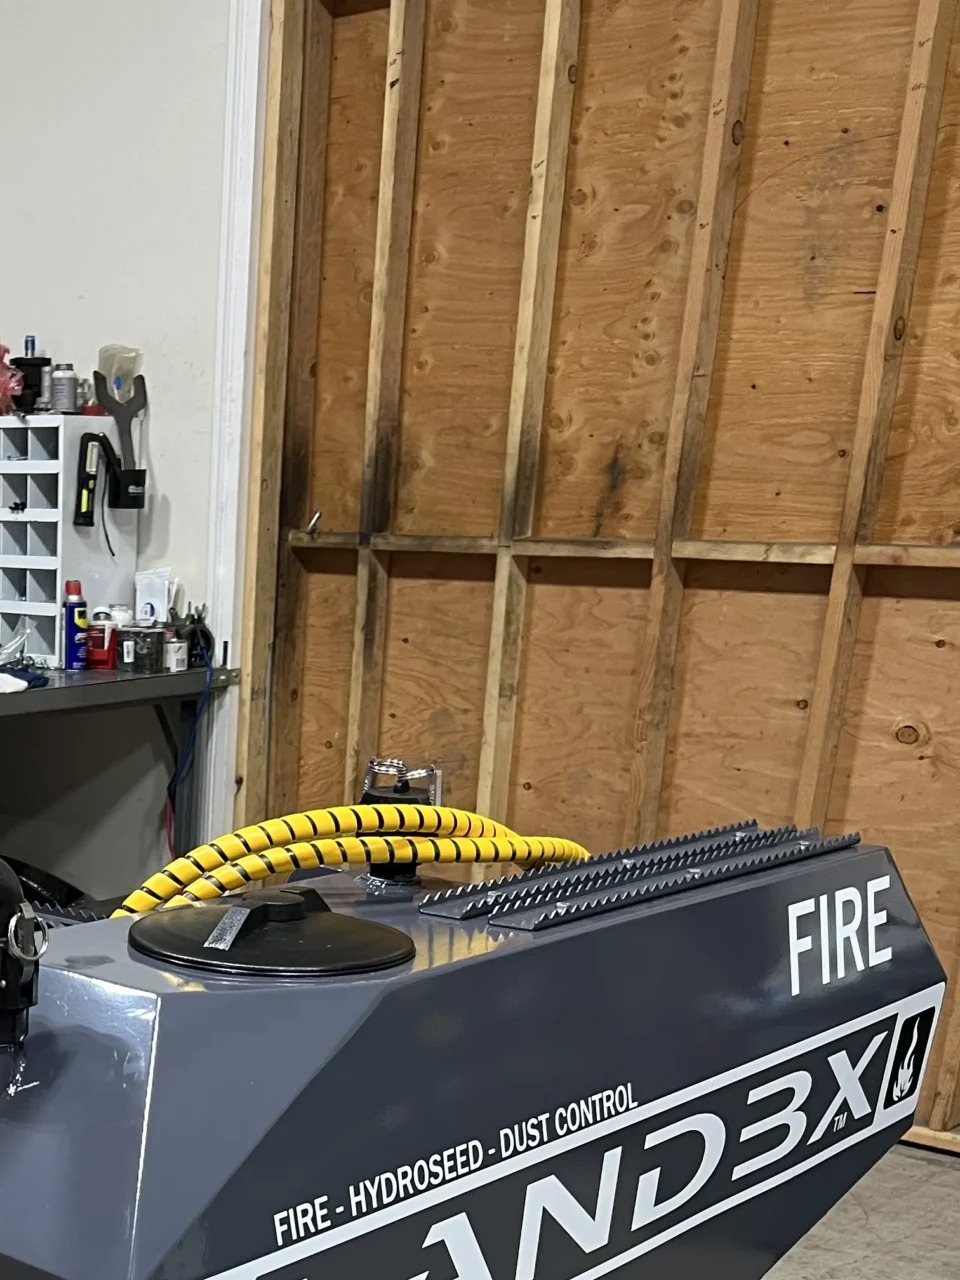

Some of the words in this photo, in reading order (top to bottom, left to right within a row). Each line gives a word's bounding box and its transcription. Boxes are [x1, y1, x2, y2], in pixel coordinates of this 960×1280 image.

[787, 874, 893, 997] FIRE
[273, 1195, 332, 1247] FIRE
[348, 1139, 484, 1217] HYDROSEED
[499, 1112, 552, 1159] DUST
[554, 1082, 639, 1137] CONTROL
[833, 1111, 848, 1133] TM
